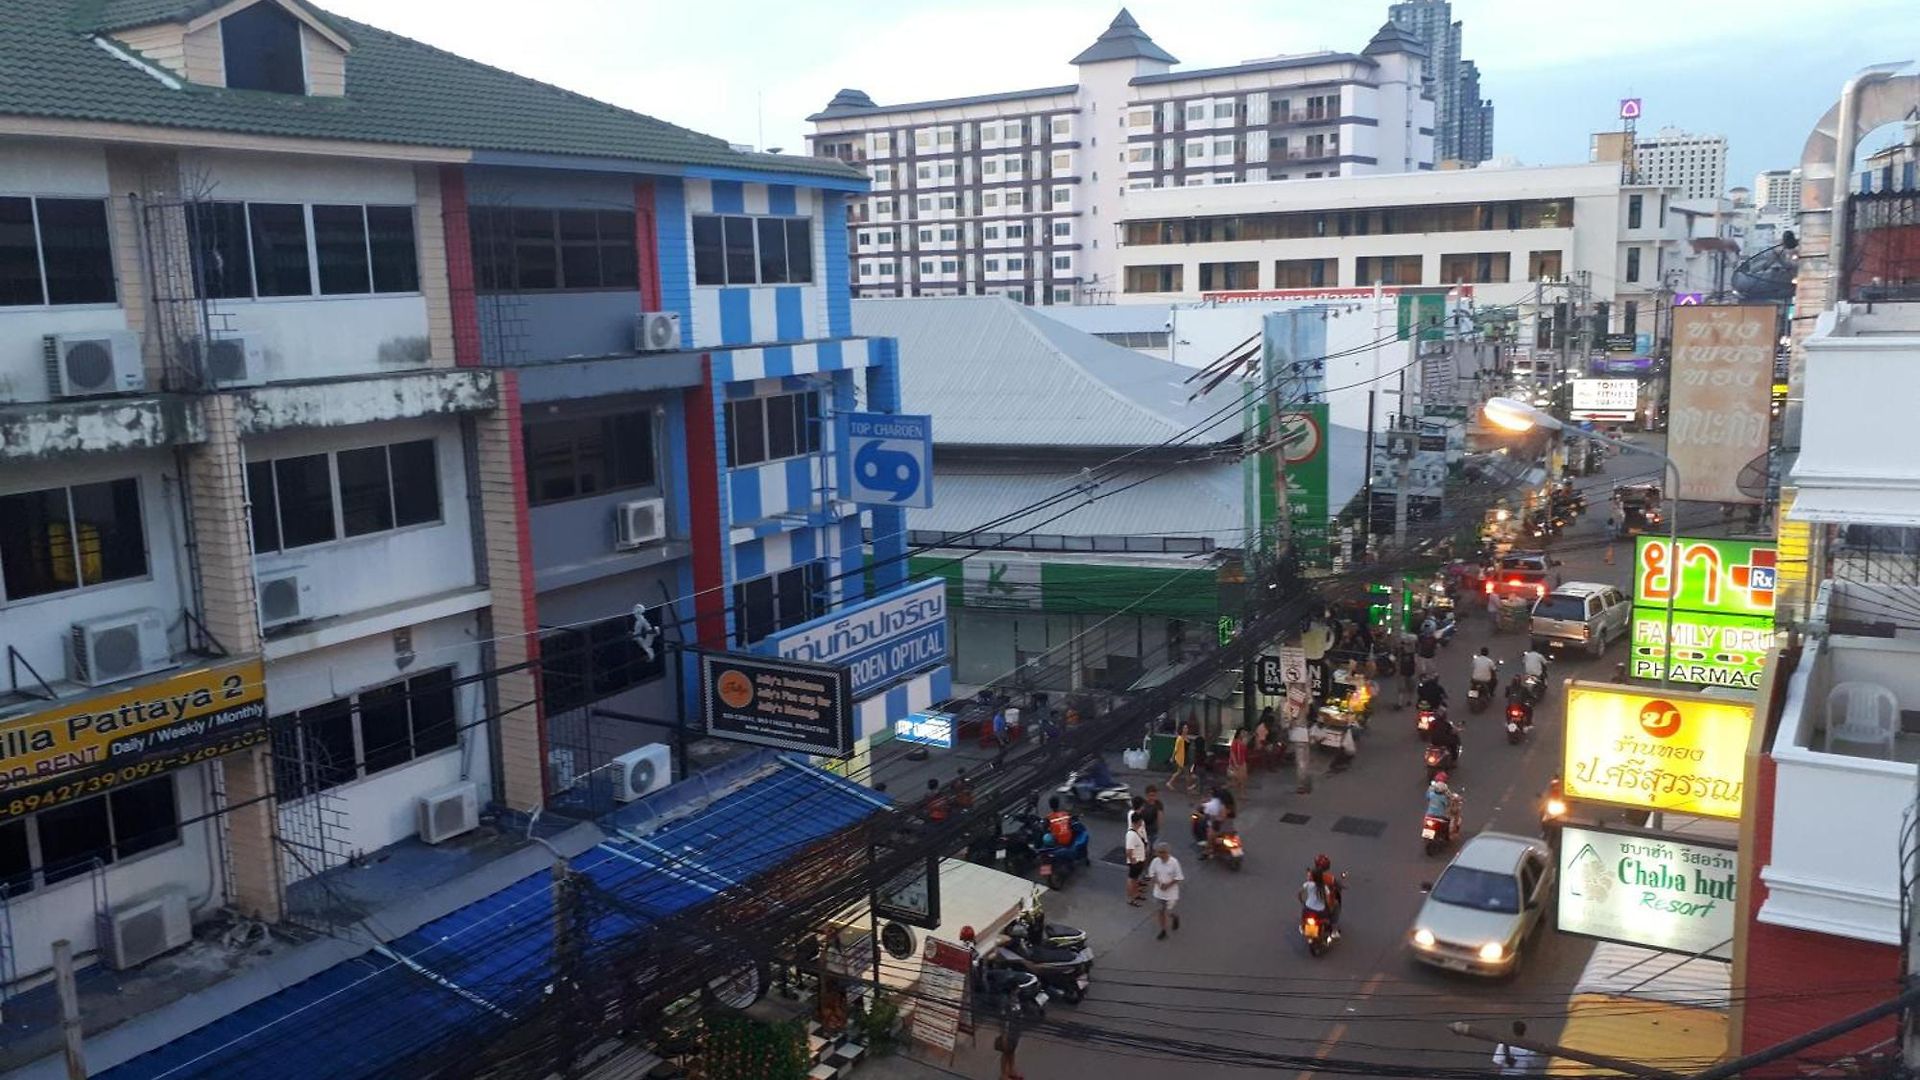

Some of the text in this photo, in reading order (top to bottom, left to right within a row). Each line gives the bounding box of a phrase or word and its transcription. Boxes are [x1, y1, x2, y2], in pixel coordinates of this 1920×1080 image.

[851, 422, 922, 438] TOP CHAROEN
[1642, 543, 1719, 604] ยา
[1752, 570, 1774, 589] Rx
[890, 630, 943, 672] OPTICAL
[1637, 621, 1716, 647] FAMILY
[66, 687, 213, 741] Pattaya
[222, 674, 243, 699] 2
[111, 736, 145, 756] Daily
[156, 720, 206, 743] Weekly
[215, 703, 265, 726] Monthly
[35, 743, 100, 778] RENT
[1614, 735, 1705, 762] ร้านทอง
[1618, 856, 1735, 901] Chaba hut
[1639, 891, 1716, 918] Resort
